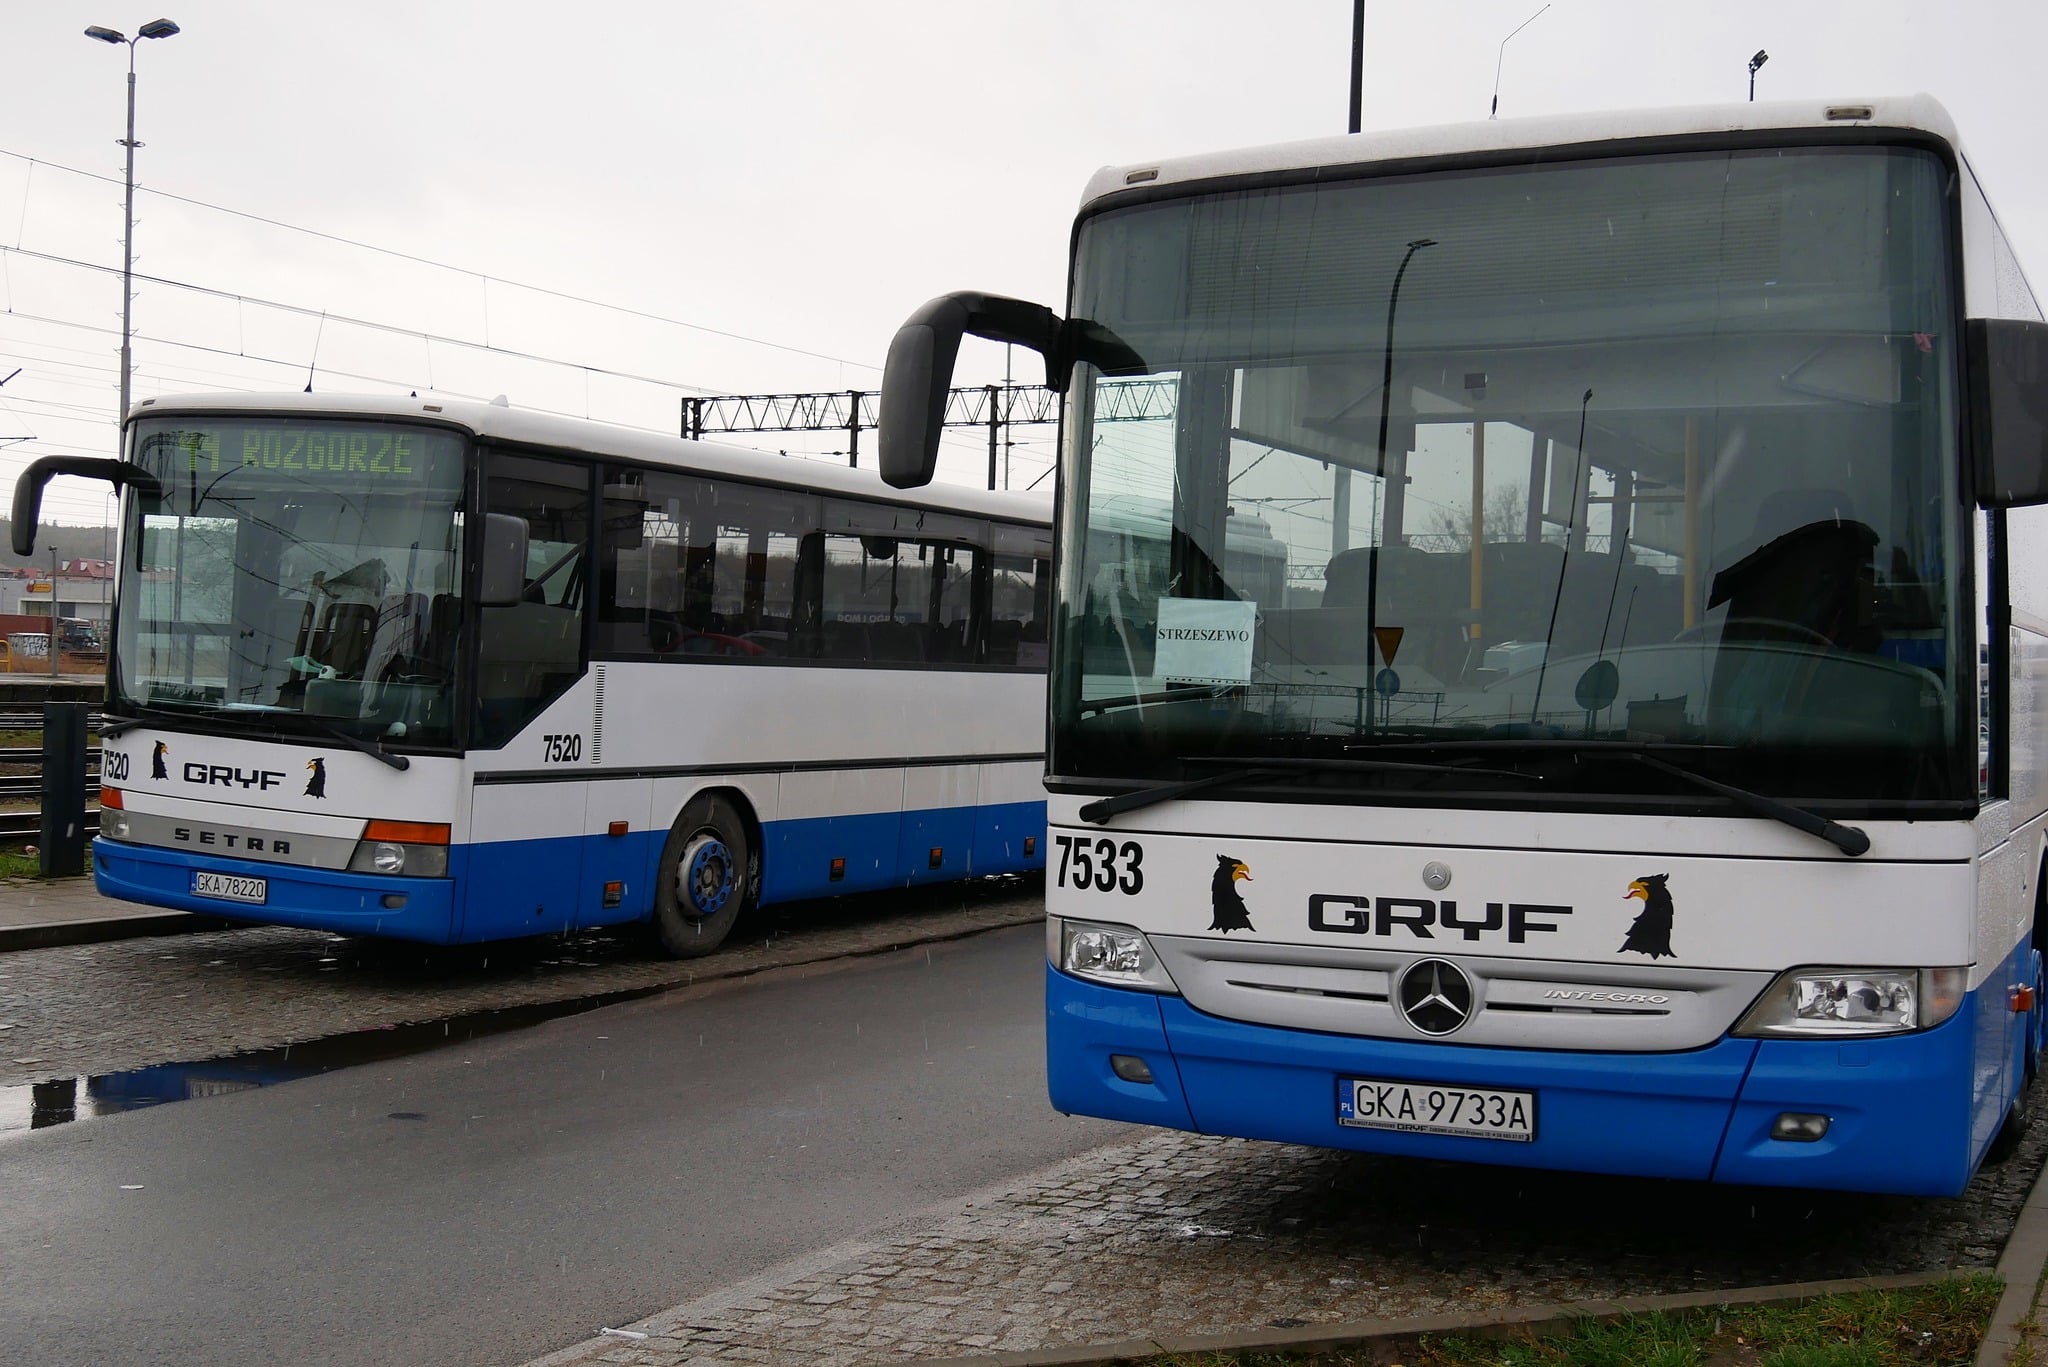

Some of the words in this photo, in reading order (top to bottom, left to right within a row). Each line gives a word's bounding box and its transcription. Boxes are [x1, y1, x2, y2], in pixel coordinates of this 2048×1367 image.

[243, 431, 412, 473] ROZGORZE
[1158, 629, 1250, 642] STRZESZEWO
[544, 734, 581, 762] 7520
[104, 750, 129, 781] 7520
[183, 762, 286, 791] GRYF
[174, 828, 290, 855] SETRA
[1056, 835, 1144, 896] 7533
[197, 874, 220, 893] GKA
[225, 878, 264, 897] 78220
[1308, 893, 1573, 944] GRYF
[1543, 989, 1669, 1004] INTEGRO
[1341, 1102, 1353, 1112] PL
[1357, 1085, 1416, 1121] GKA
[1428, 1090, 1528, 1130] 9733A
